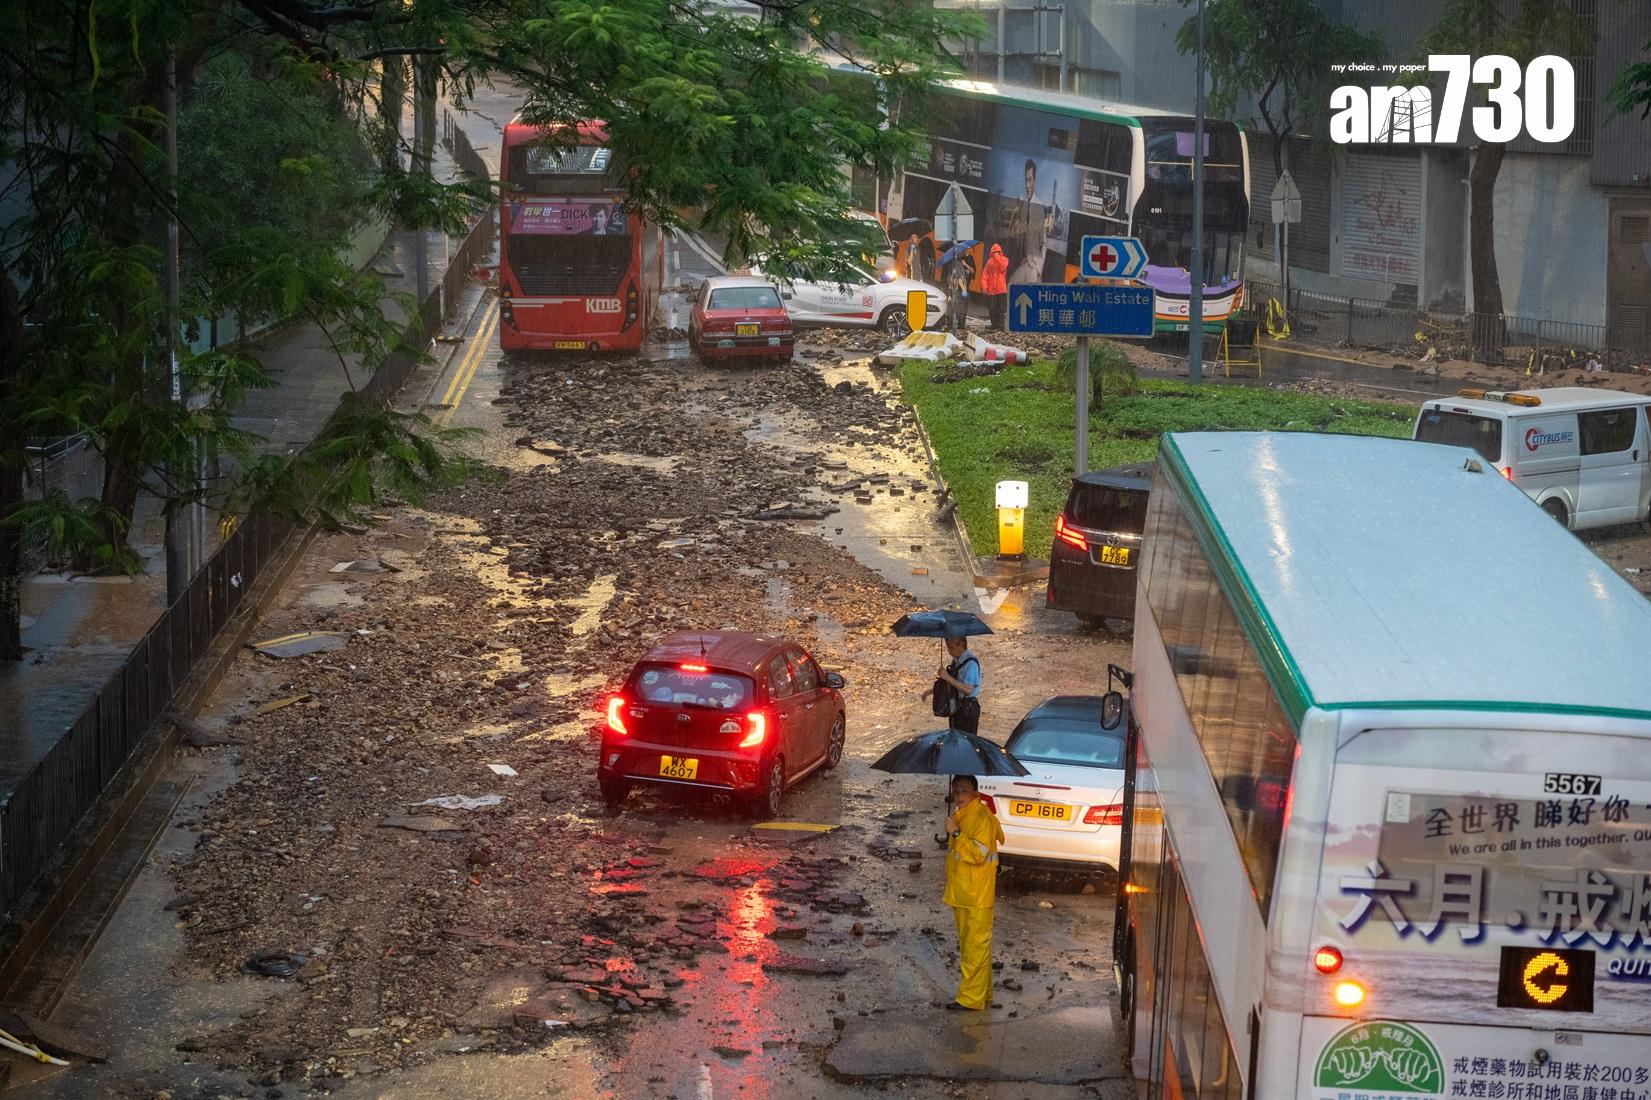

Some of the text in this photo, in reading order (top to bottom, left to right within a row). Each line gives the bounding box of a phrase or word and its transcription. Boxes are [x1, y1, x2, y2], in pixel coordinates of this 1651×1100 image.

[1038, 290, 1150, 305] Hing Wah Estate
[585, 298, 622, 313] KMB
[1039, 308, 1096, 328] 興華邨
[1532, 432, 1560, 444] CITYBUS
[1109, 547, 1122, 556] CC
[1103, 554, 1127, 565] 7789
[670, 756, 687, 767] WX
[662, 766, 694, 778] 4607
[1545, 775, 1600, 795] 5567
[1016, 803, 1065, 818] CP 1618
[1424, 802, 1520, 839] 全世界
[1534, 794, 1630, 829] 睇好你
[1450, 843, 1470, 855] We
[1474, 843, 1497, 854] are
[1501, 840, 1517, 852] all
[1521, 839, 1532, 850] in
[1536, 836, 1561, 849] this
[1566, 832, 1629, 849] together.
